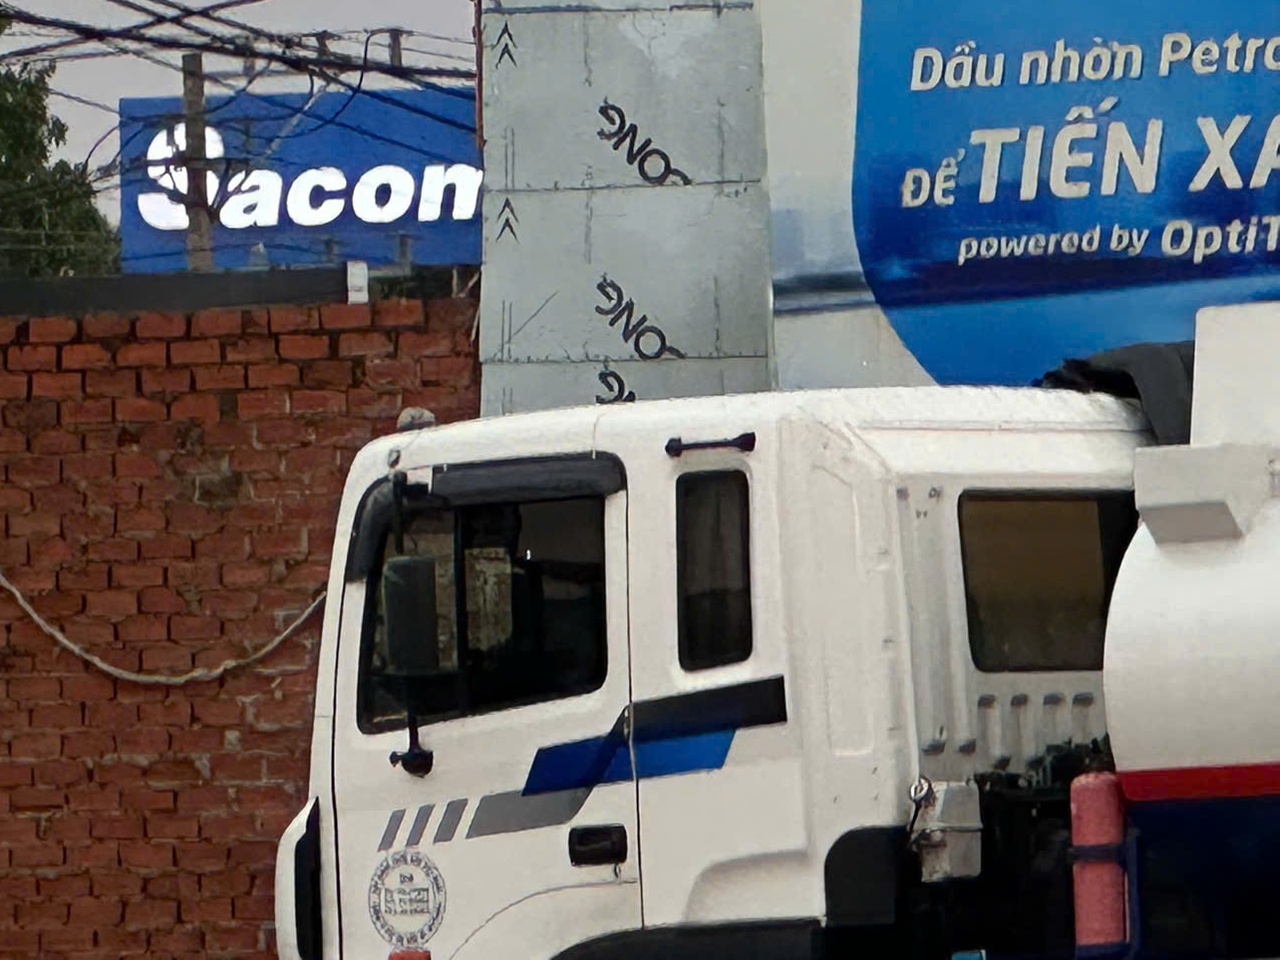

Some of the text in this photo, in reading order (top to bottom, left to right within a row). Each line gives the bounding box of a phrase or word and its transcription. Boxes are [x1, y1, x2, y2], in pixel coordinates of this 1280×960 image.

[910, 40, 1006, 91] Dầu
[970, 95, 1164, 204] TIẾN
[957, 224, 1101, 266] powered
[1109, 224, 1150, 256] by
